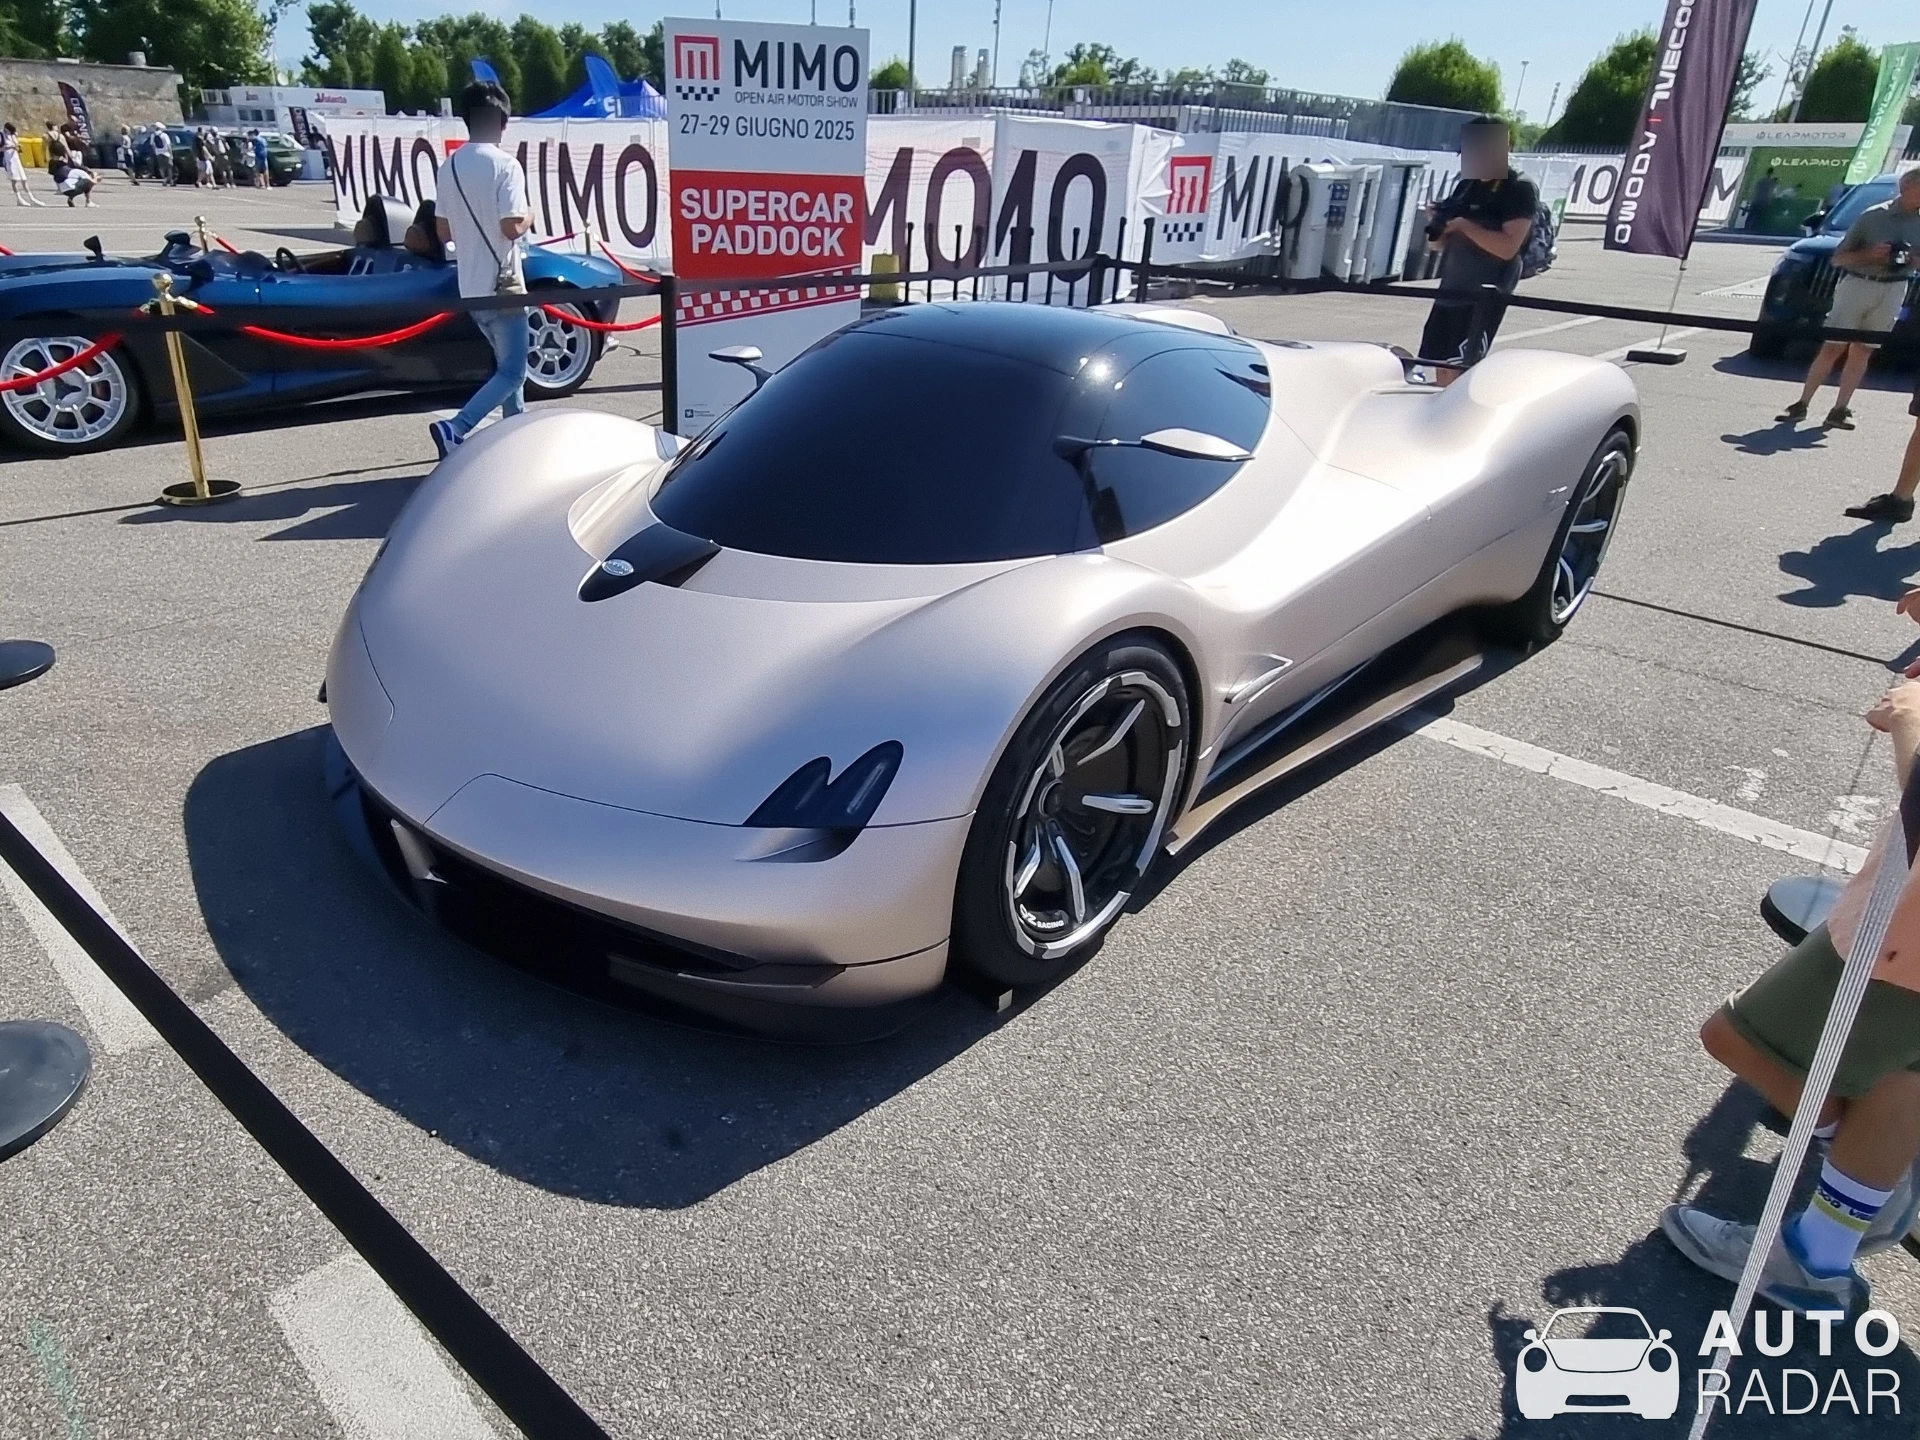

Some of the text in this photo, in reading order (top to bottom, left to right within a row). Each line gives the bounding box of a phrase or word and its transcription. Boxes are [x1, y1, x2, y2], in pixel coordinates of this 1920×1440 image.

[734, 39, 860, 92] MIMO
[735, 91, 859, 108] OPEN AIR MOTOR SHOW
[680, 114, 855, 140] 27-29 GIUGNO 2025
[1767, 131, 1846, 140] LEAPMOTOR
[516, 141, 658, 248] IMO
[681, 188, 854, 223] SUPERCAR
[692, 224, 845, 257] PADDOCK
[1037, 920, 1064, 928] RACING
